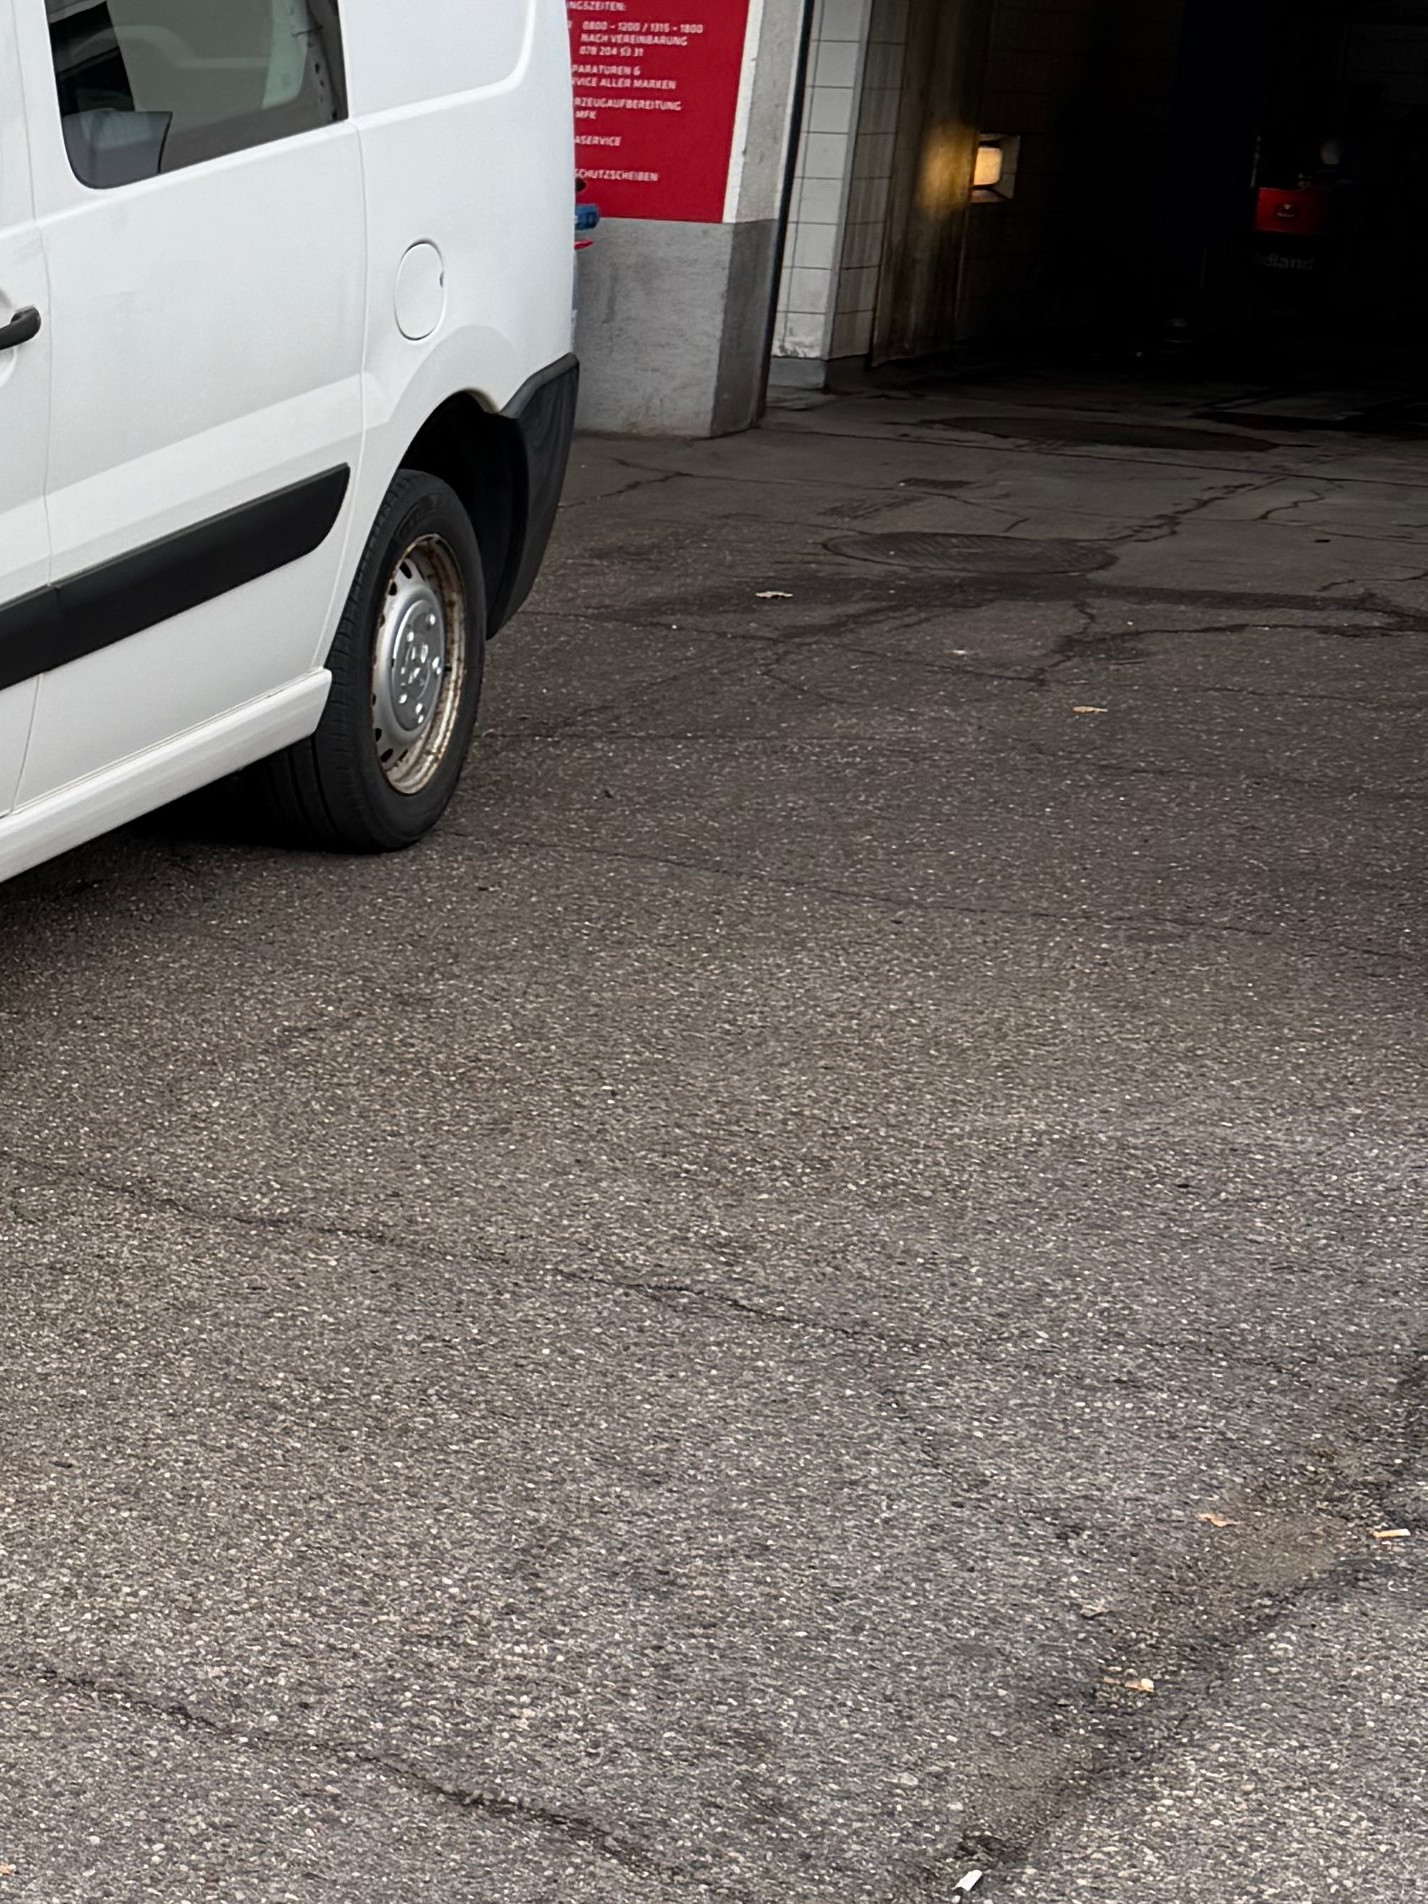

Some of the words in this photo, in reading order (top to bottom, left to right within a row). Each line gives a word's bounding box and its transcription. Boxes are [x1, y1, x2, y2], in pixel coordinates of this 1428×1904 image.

[581, 34, 608, 43] NACH
[611, 34, 688, 46] VEREINBARUNG
[572, 64, 631, 75] PARATUREN
[599, 78, 631, 88] ALLER
[633, 79, 677, 90] MARKEN
[574, 97, 682, 111] RZEUGAUFBEREITUNG
[573, 135, 622, 146] ASERVICE
